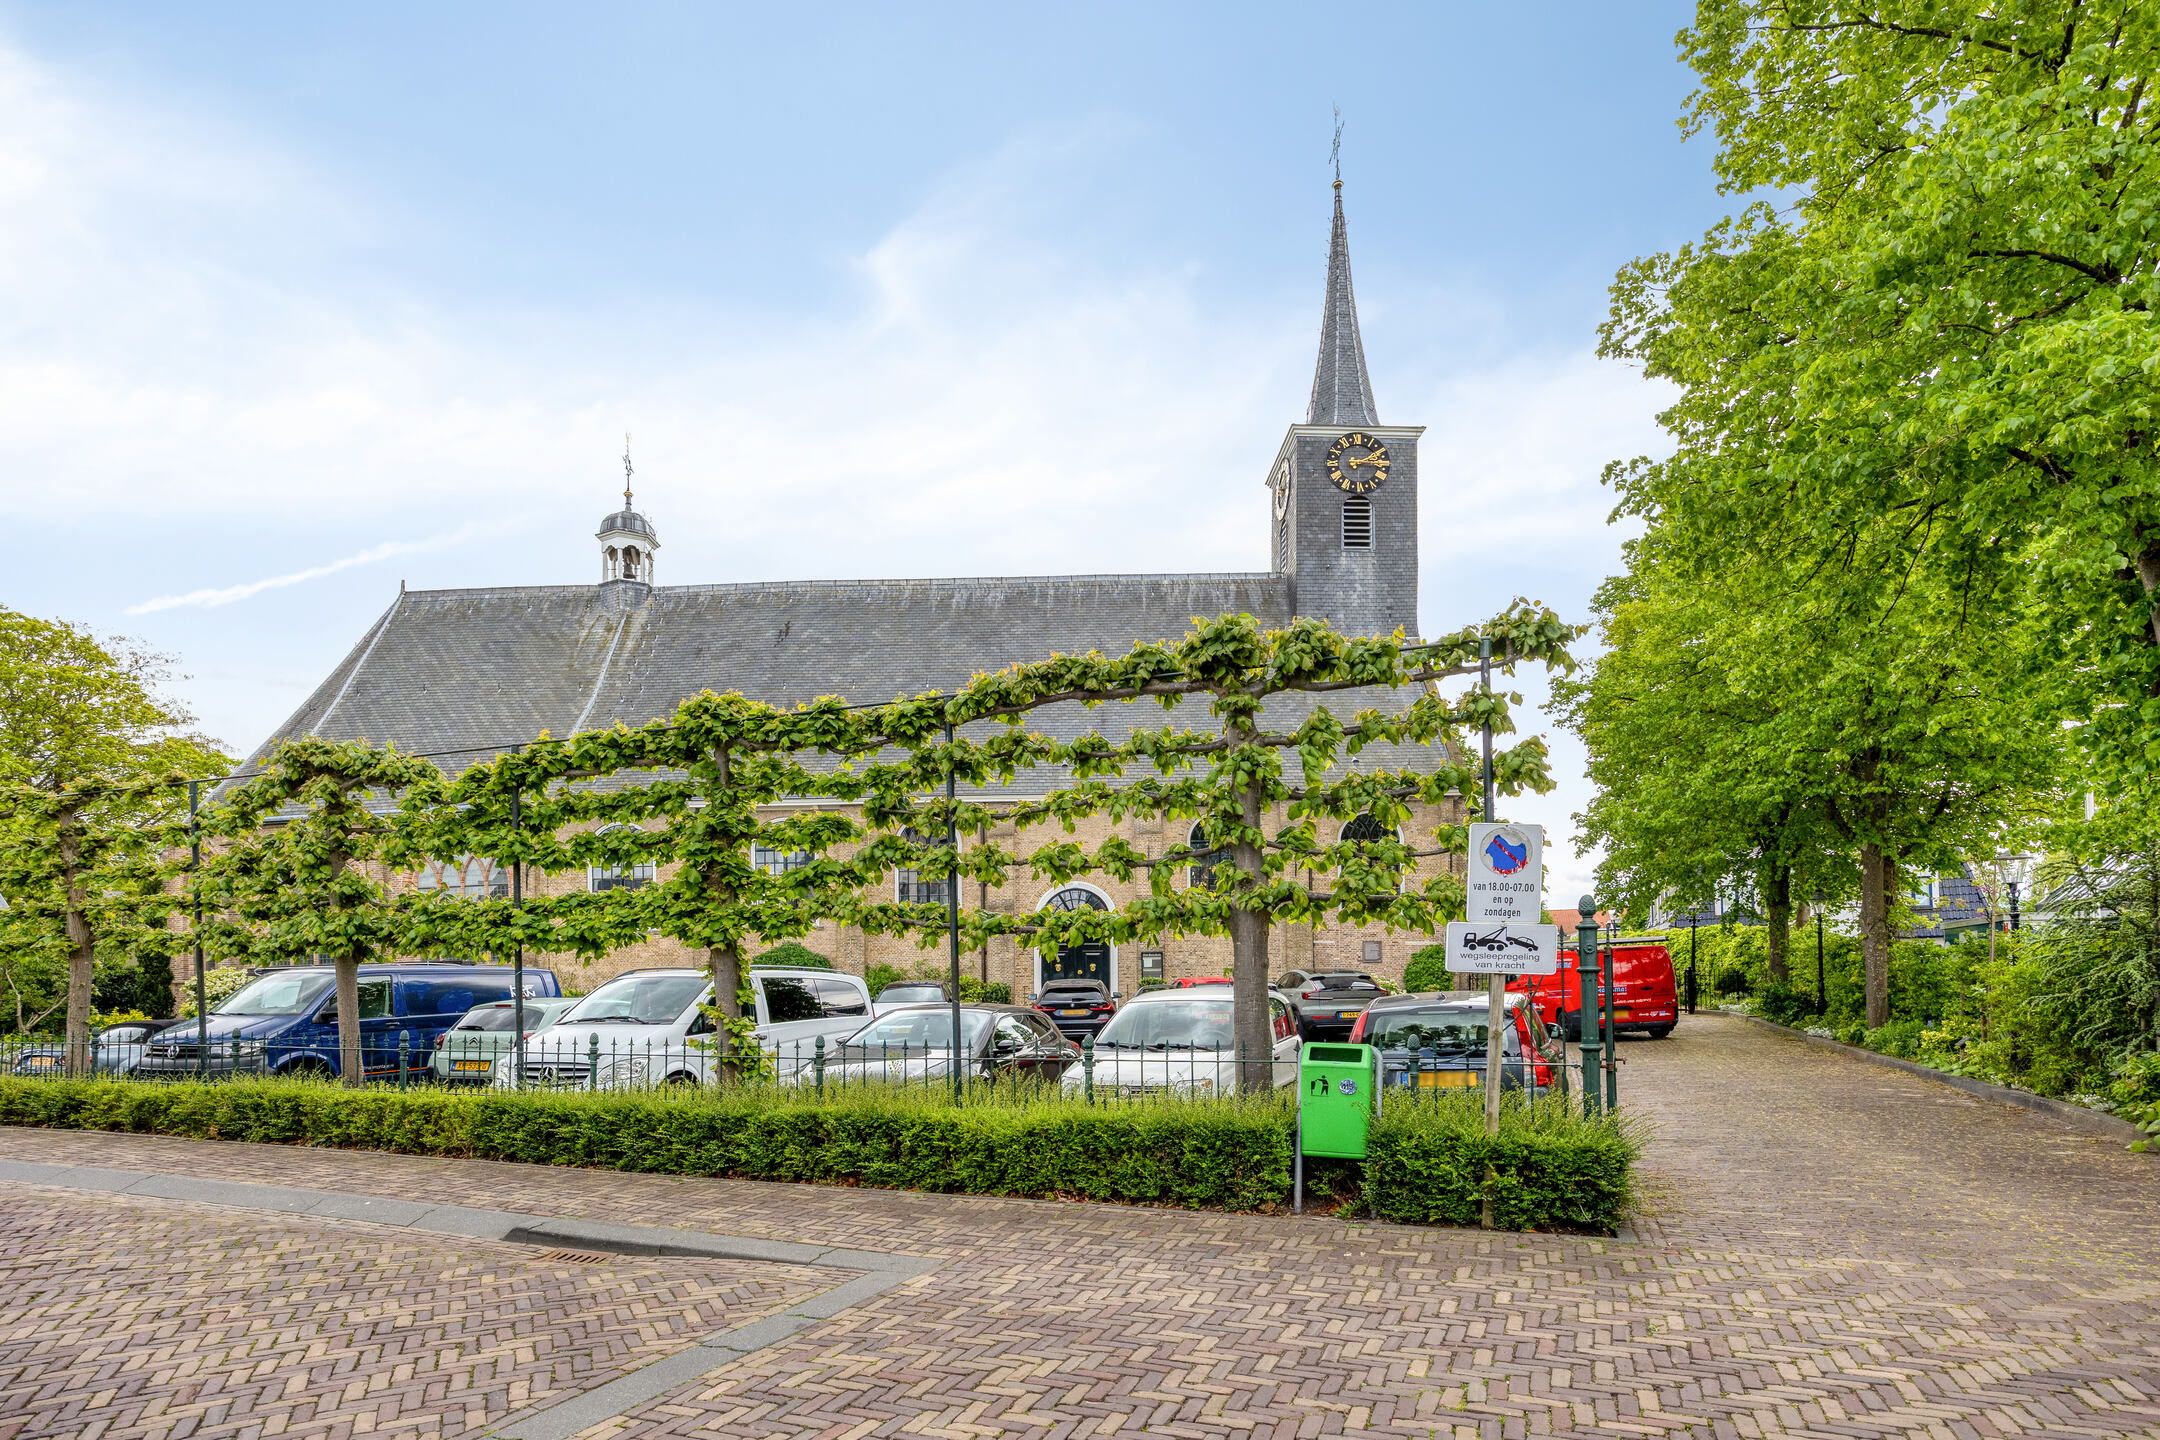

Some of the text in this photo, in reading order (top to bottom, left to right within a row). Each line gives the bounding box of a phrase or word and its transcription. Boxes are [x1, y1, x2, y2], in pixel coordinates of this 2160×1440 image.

[1473, 882, 1534, 892] van 18.00-07.00
[1504, 896, 1514, 906] op
[1484, 908, 1520, 918] zondagen
[1460, 952, 1540, 963] wegsleepregeling
[1475, 961, 1526, 970] van kracht
